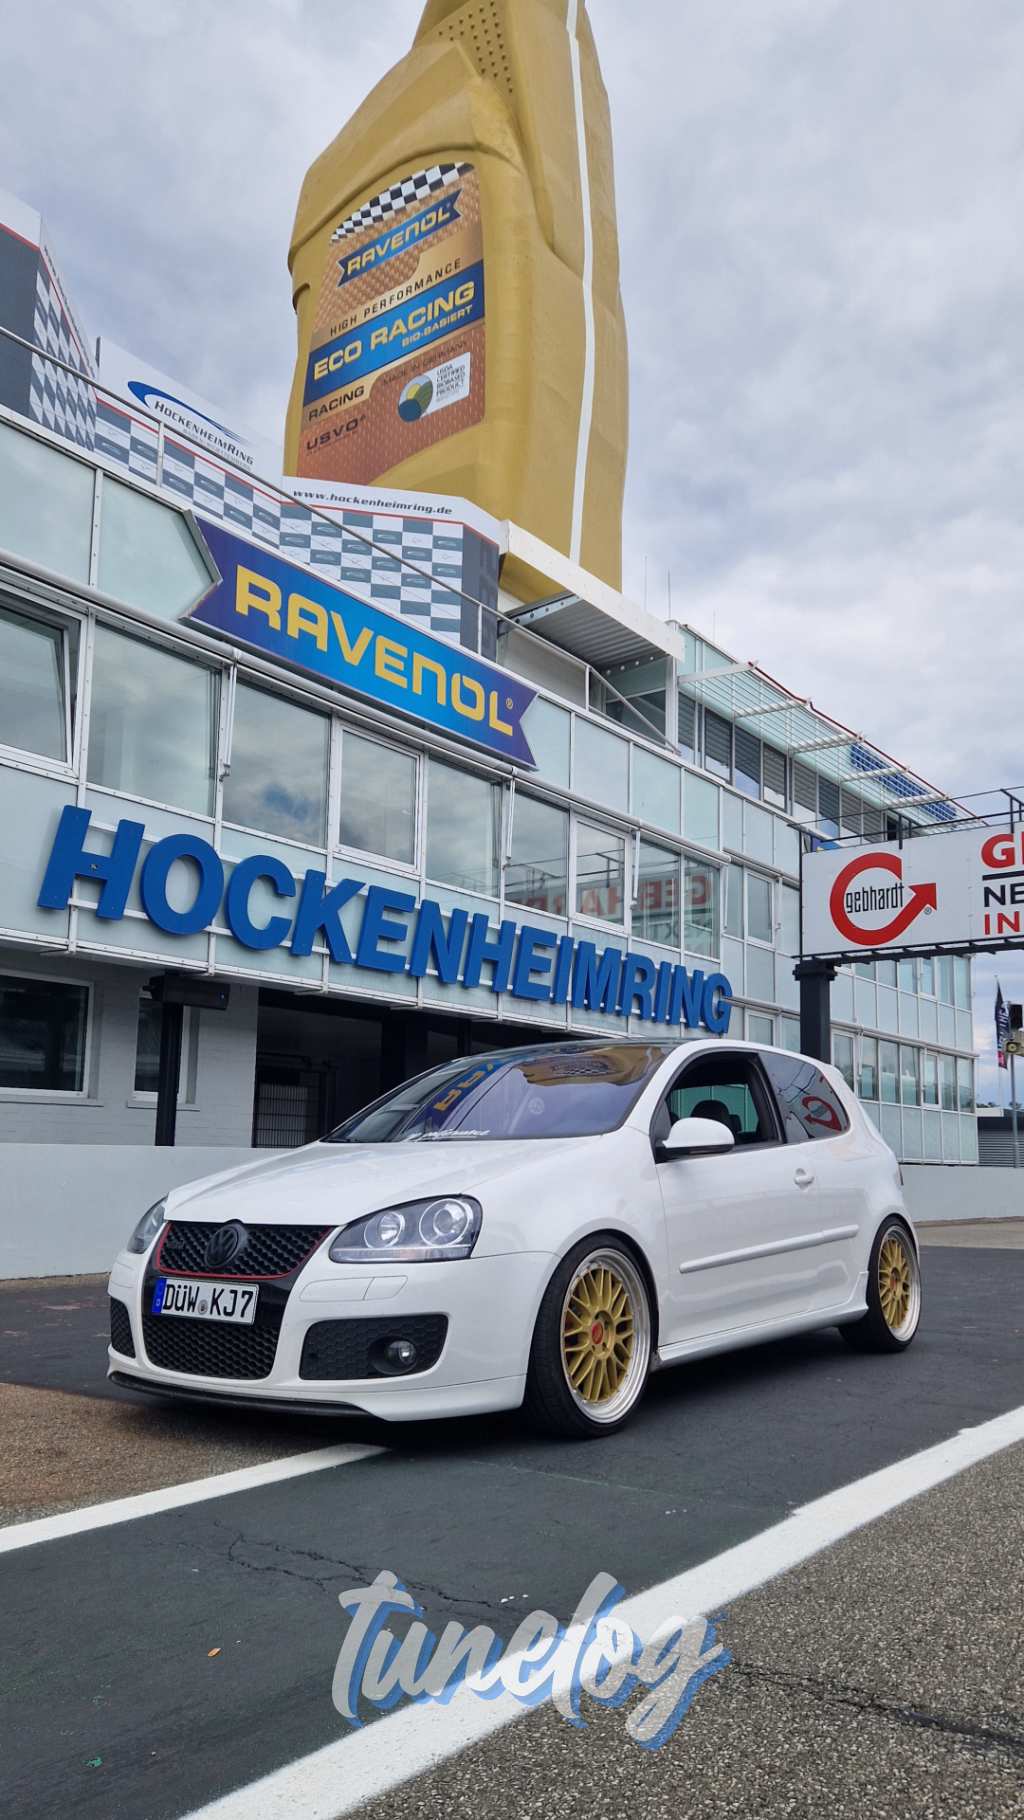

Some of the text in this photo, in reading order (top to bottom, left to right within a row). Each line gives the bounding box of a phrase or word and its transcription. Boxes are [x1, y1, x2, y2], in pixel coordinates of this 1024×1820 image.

[330, 257, 463, 337] HIGH PERFORMANCE
[313, 280, 475, 380] ECO RACING
[308, 385, 365, 422] RACING
[293, 489, 453, 515] www.hockenheimring.de
[234, 564, 514, 736] RAVENOL
[982, 831, 1024, 869] G
[845, 882, 905, 914] gebhardt
[36, 804, 733, 1034] HOCKENHEIMRING
[162, 1284, 200, 1313] DÜW
